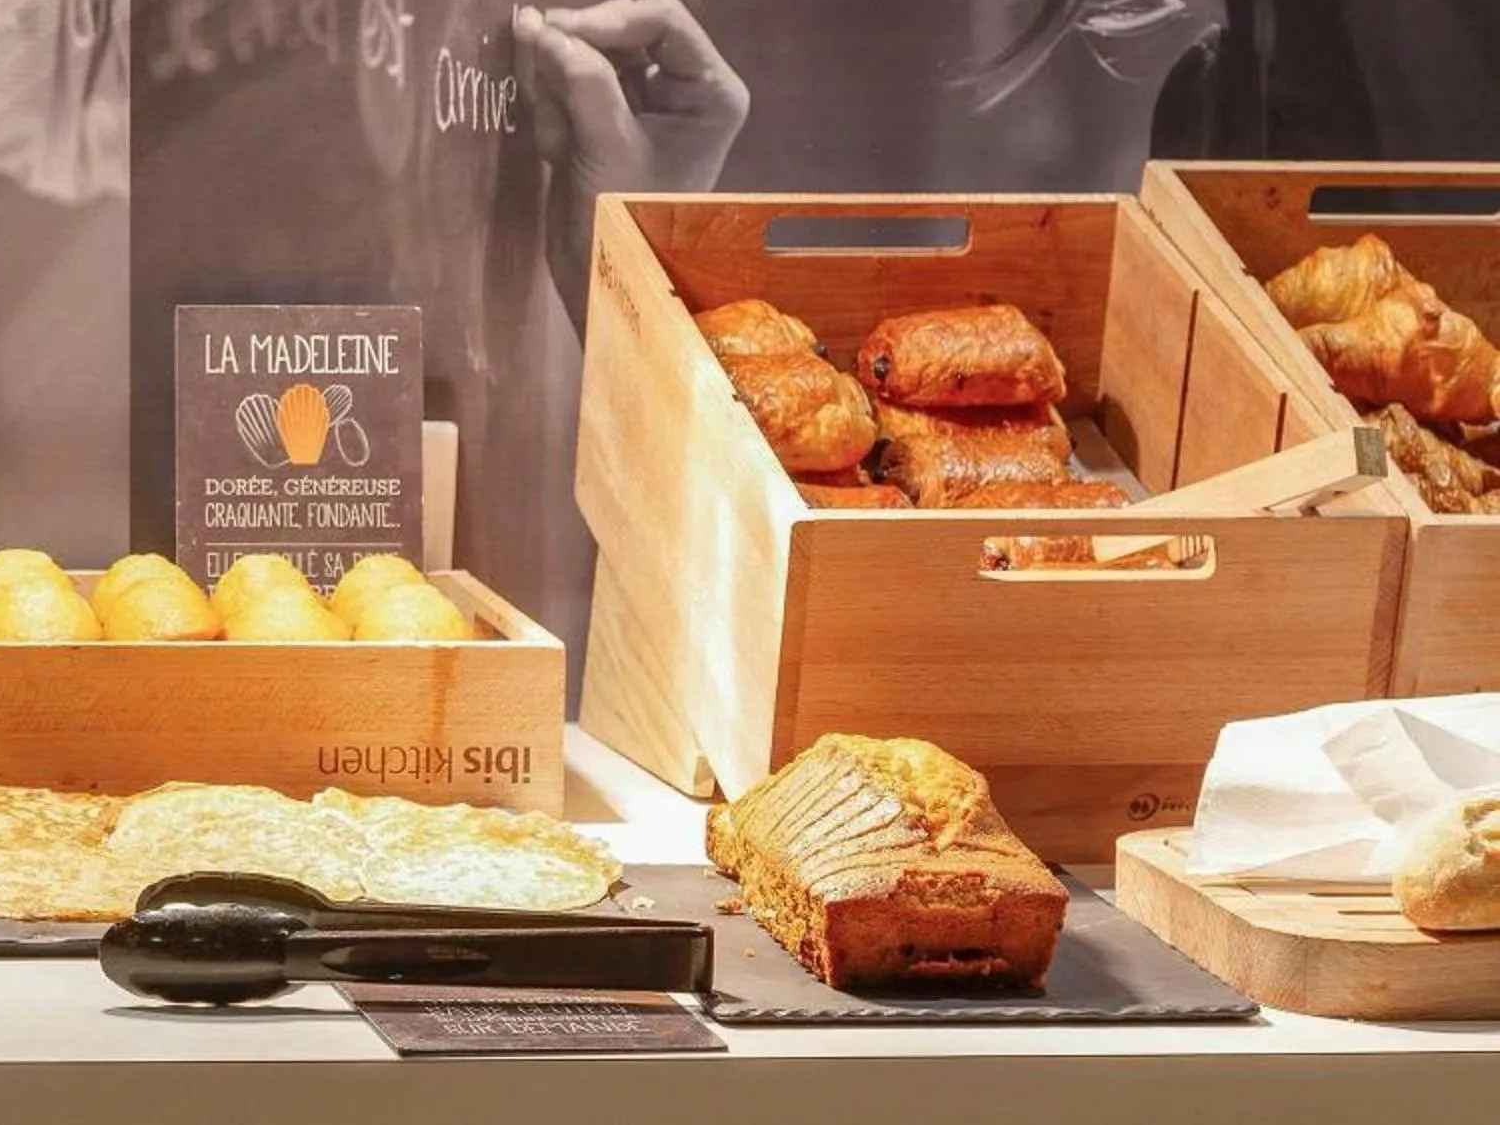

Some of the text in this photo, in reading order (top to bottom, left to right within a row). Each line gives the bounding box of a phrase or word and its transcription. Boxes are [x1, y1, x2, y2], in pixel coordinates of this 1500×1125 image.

[204, 334, 399, 374] LA MADELEINE
[204, 475, 401, 497] DORÉE, GÉNÉREUSE
[323, 552, 345, 578] SA
[317, 746, 531, 784] ibis kitchen
